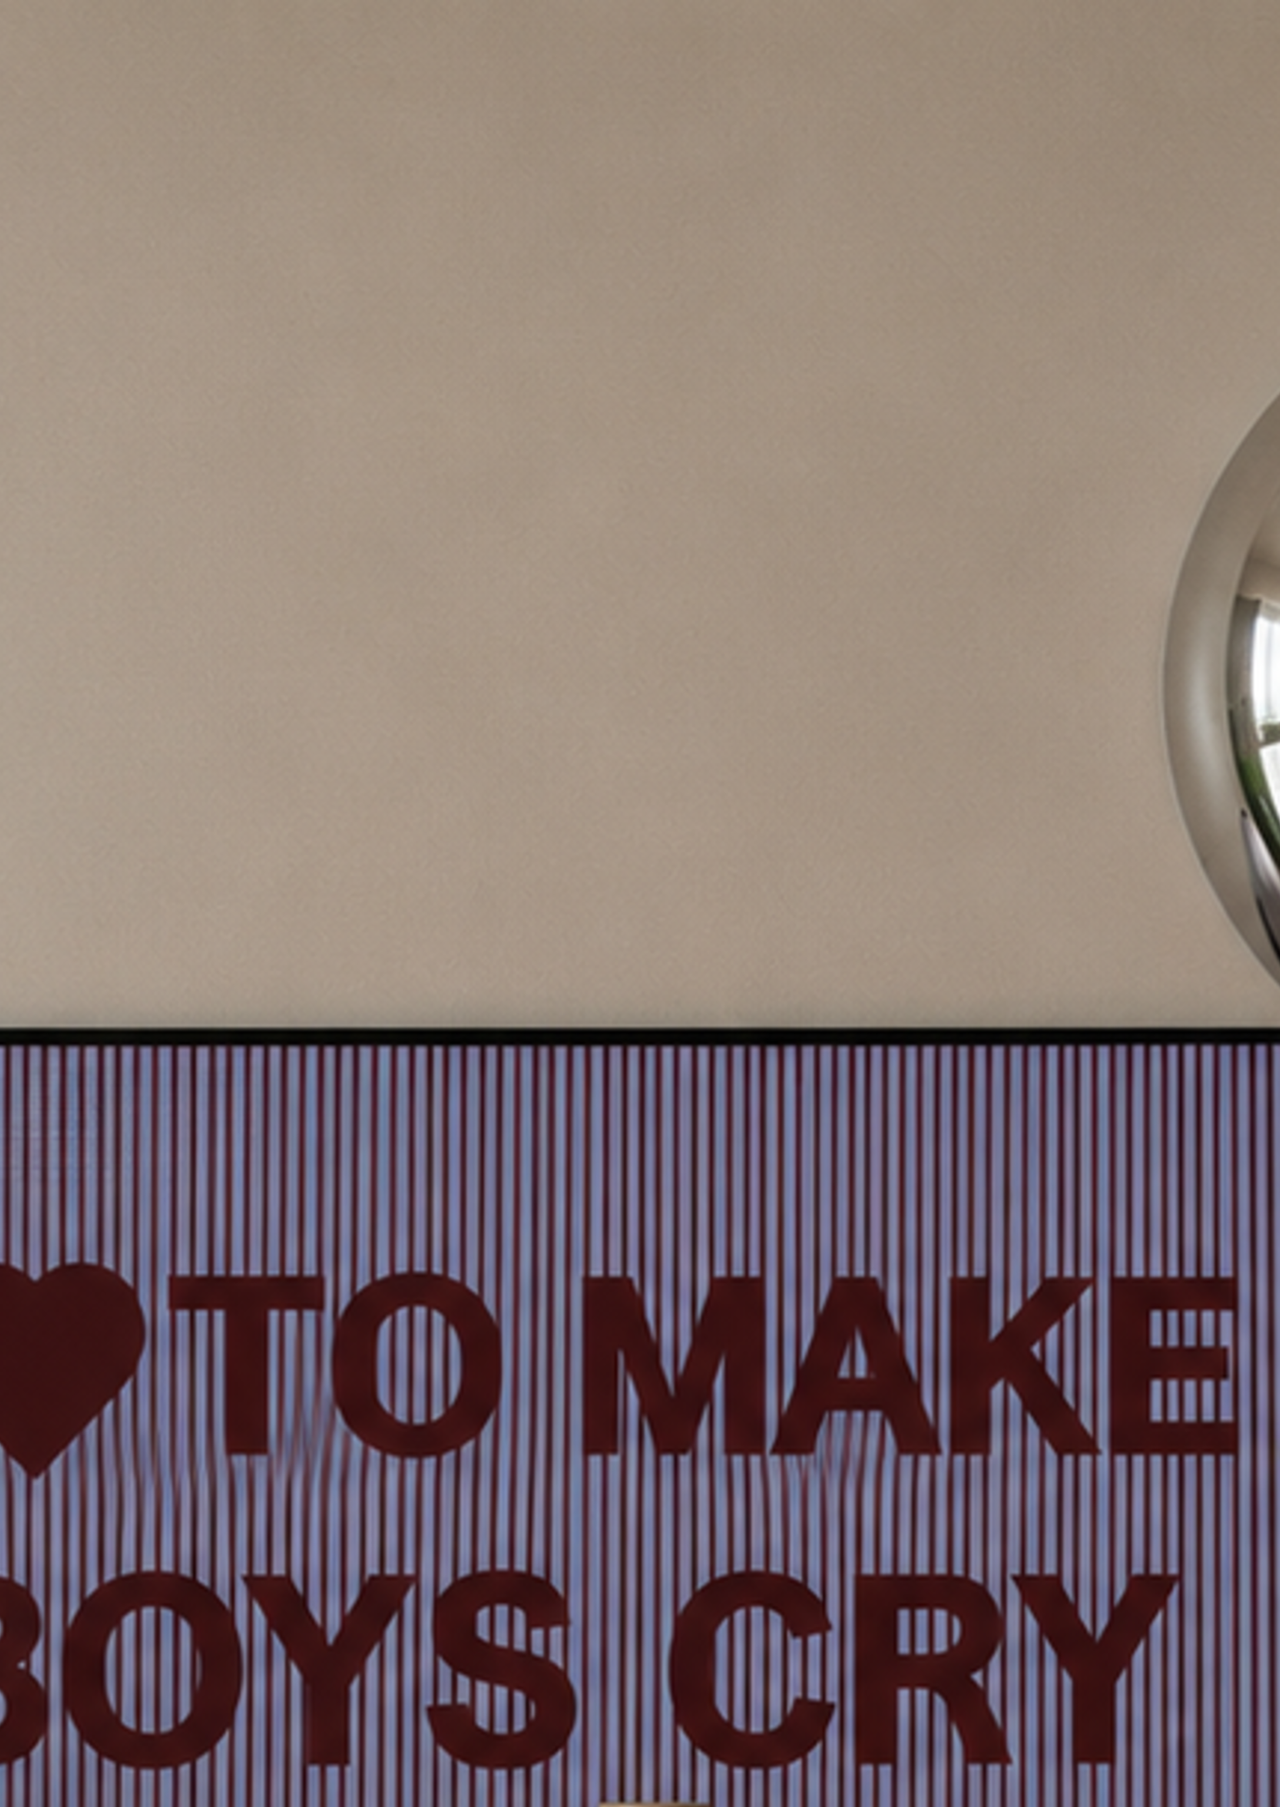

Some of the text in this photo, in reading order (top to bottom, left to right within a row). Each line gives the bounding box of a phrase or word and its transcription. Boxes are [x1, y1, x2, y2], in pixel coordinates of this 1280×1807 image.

[169, 1271, 503, 1459] TO
[582, 1276, 1240, 1456] MAKE
[668, 1570, 1178, 1769] CRY
